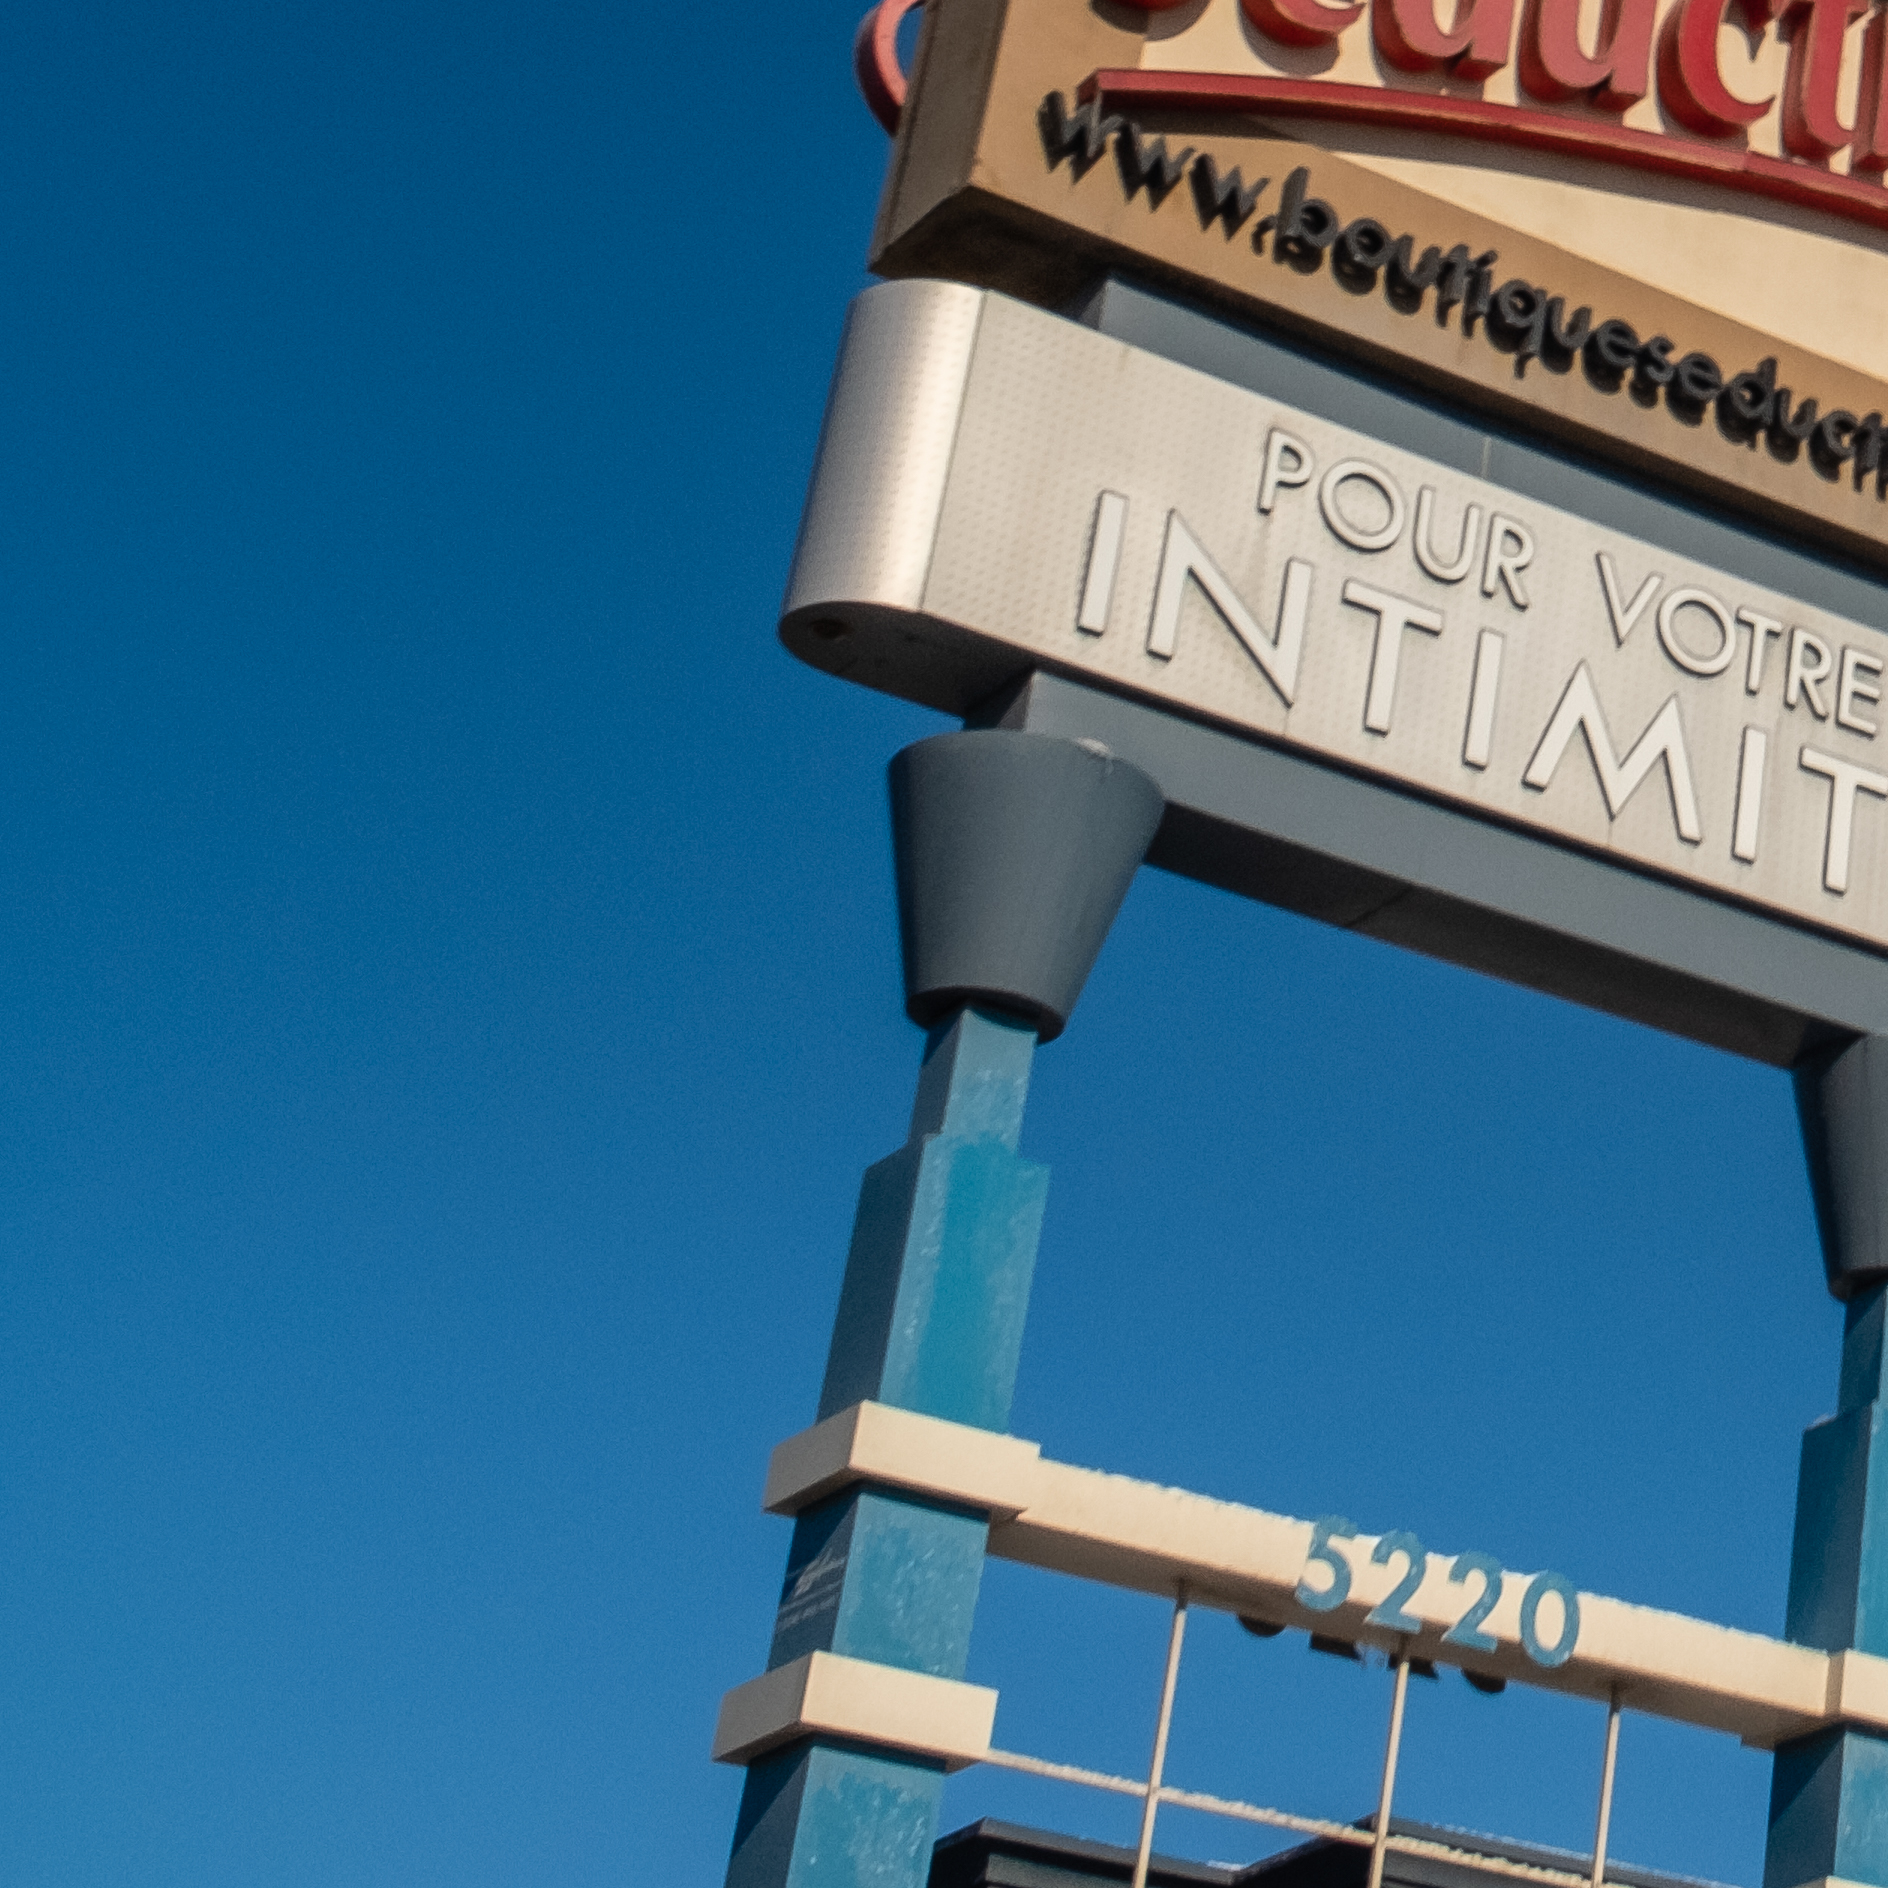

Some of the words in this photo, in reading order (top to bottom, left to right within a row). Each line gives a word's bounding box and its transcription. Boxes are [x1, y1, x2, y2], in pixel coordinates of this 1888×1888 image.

[1257, 428, 1535, 608] POUR
[1597, 552, 1884, 736] VOTRE
[1295, 1515, 1580, 1668] 5220
